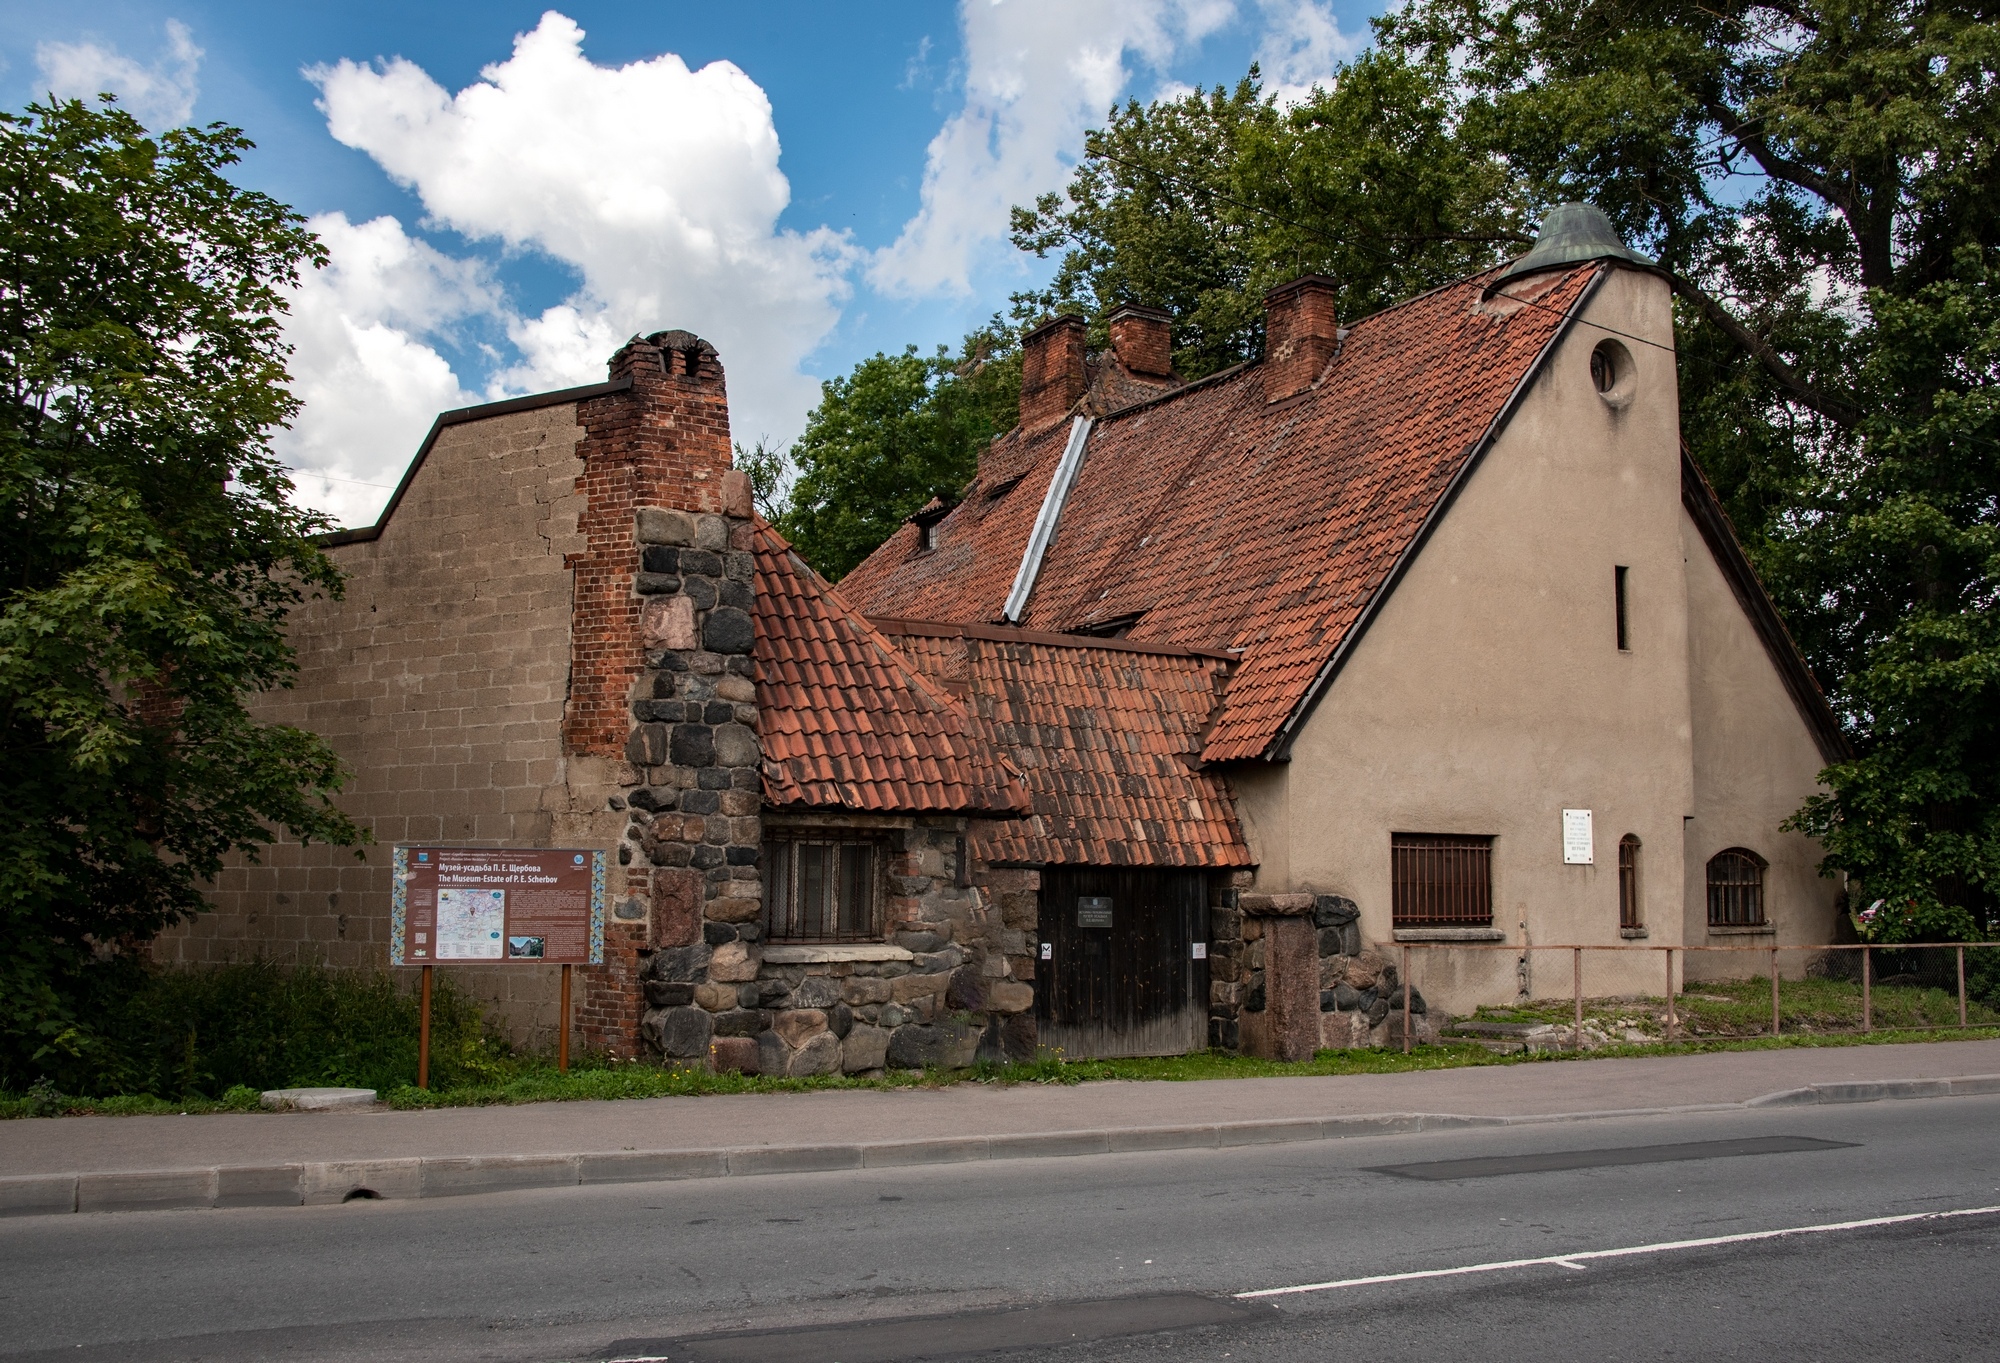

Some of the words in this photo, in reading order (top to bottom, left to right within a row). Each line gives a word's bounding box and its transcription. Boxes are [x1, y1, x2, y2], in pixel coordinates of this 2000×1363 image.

[438, 863, 492, 873] Музей-усадьба
[493, 864, 500, 872] П.
[509, 864, 541, 874] Щербова
[438, 874, 451, 882] The
[452, 874, 504, 882] Museum-Estate
[505, 874, 513, 882] of
[528, 875, 558, 883] Scherbov
